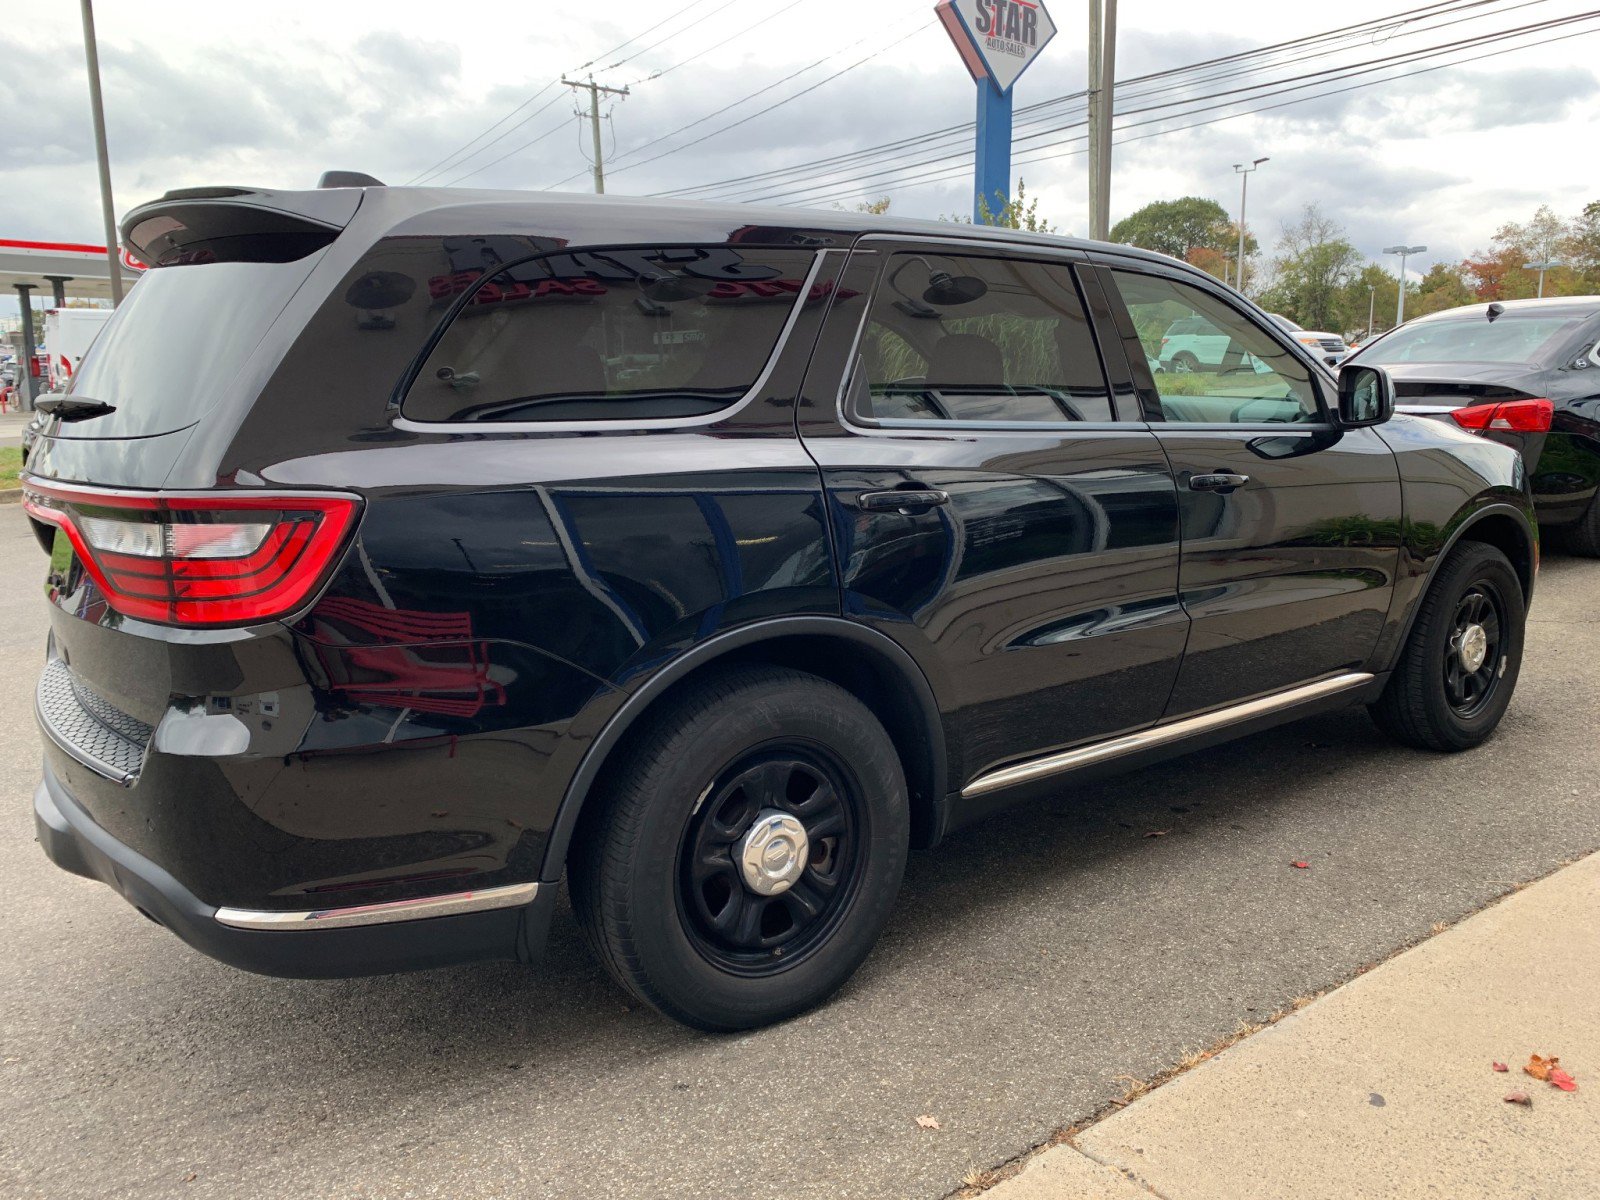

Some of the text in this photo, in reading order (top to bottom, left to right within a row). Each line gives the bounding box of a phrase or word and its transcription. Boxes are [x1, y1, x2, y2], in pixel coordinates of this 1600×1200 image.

[976, 0, 1037, 46] STAR
[986, 37, 1025, 56] AUTO SALES
